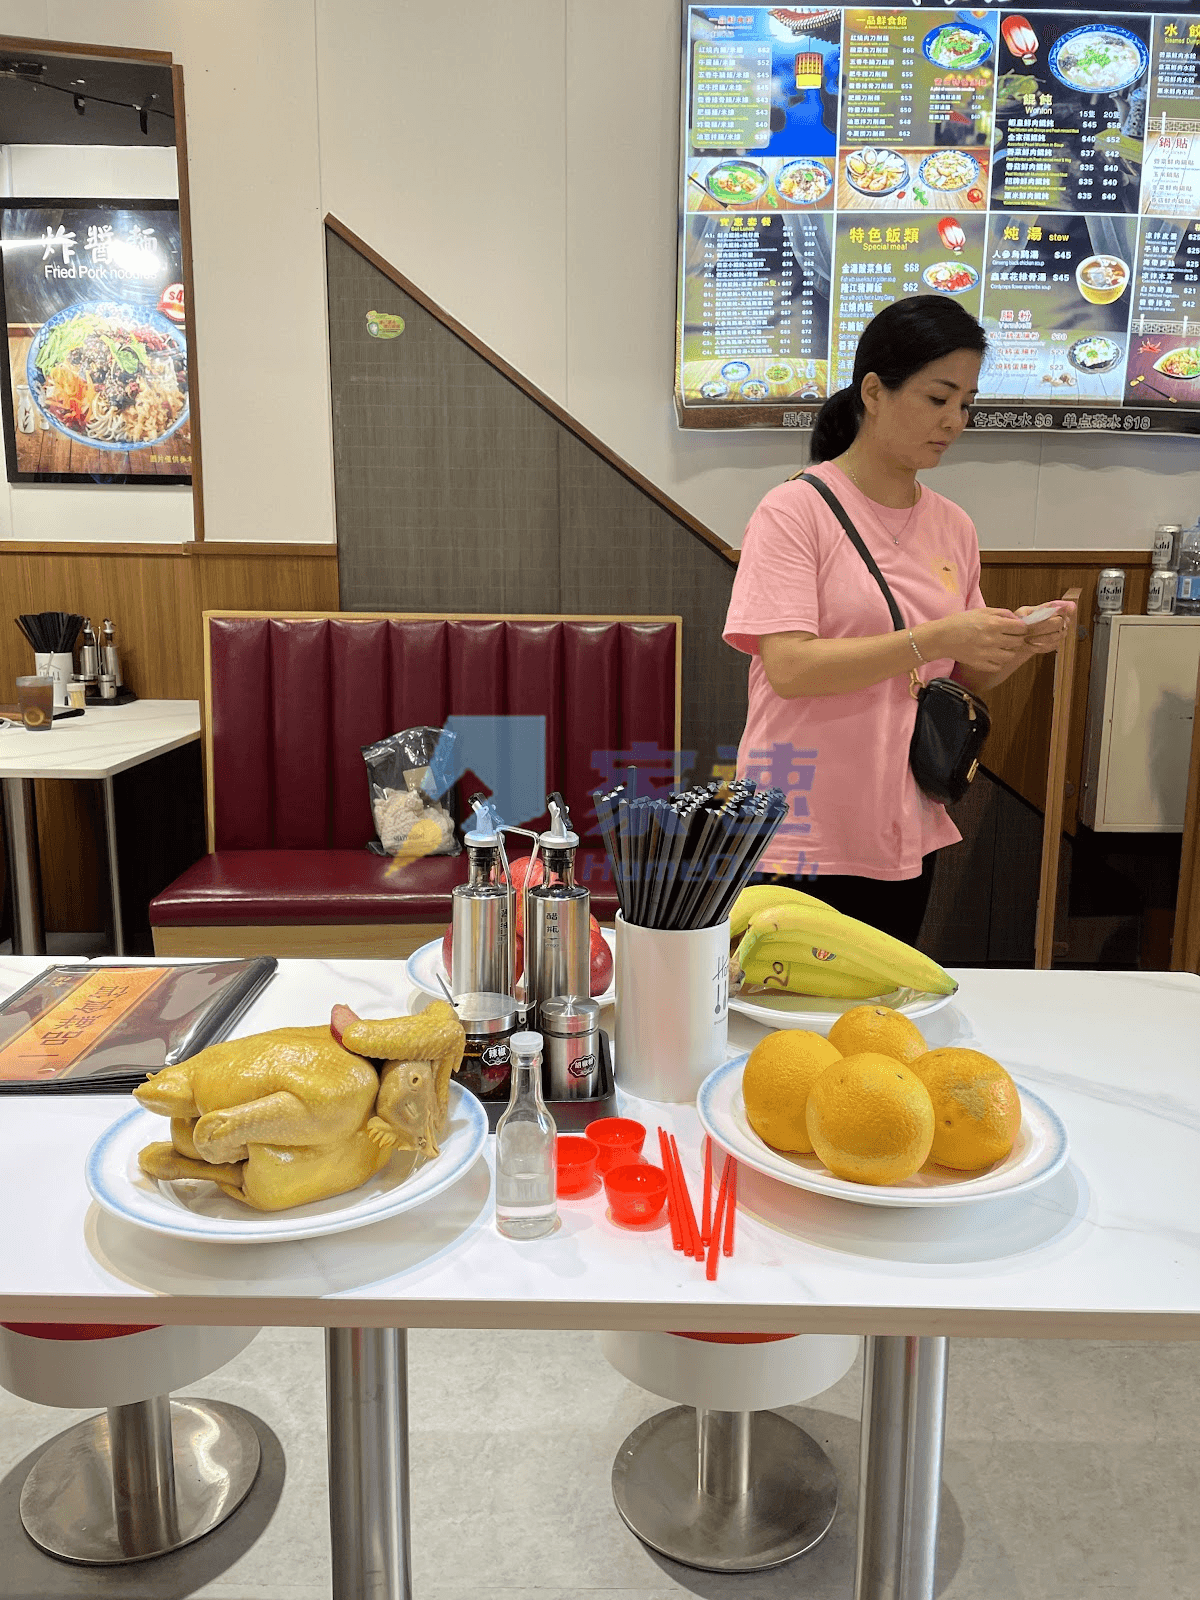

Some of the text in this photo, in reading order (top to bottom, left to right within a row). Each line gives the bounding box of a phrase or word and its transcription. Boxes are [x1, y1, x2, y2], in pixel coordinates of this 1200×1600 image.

[856, 16, 907, 26] 一品鮮食館
[1025, 106, 1052, 115] Wonton
[1104, 164, 1118, 172] $40
[1079, 178, 1093, 186] $35
[849, 228, 919, 243] 特色飯類
[863, 243, 890, 251] Special
[45, 265, 76, 279] Fried
[79, 266, 106, 279] Pork
[904, 264, 919, 272] $68
[903, 284, 918, 292] $62
[974, 412, 1053, 427] 各式汽水 $6
[1063, 413, 1150, 430] 单点茶水 $18
